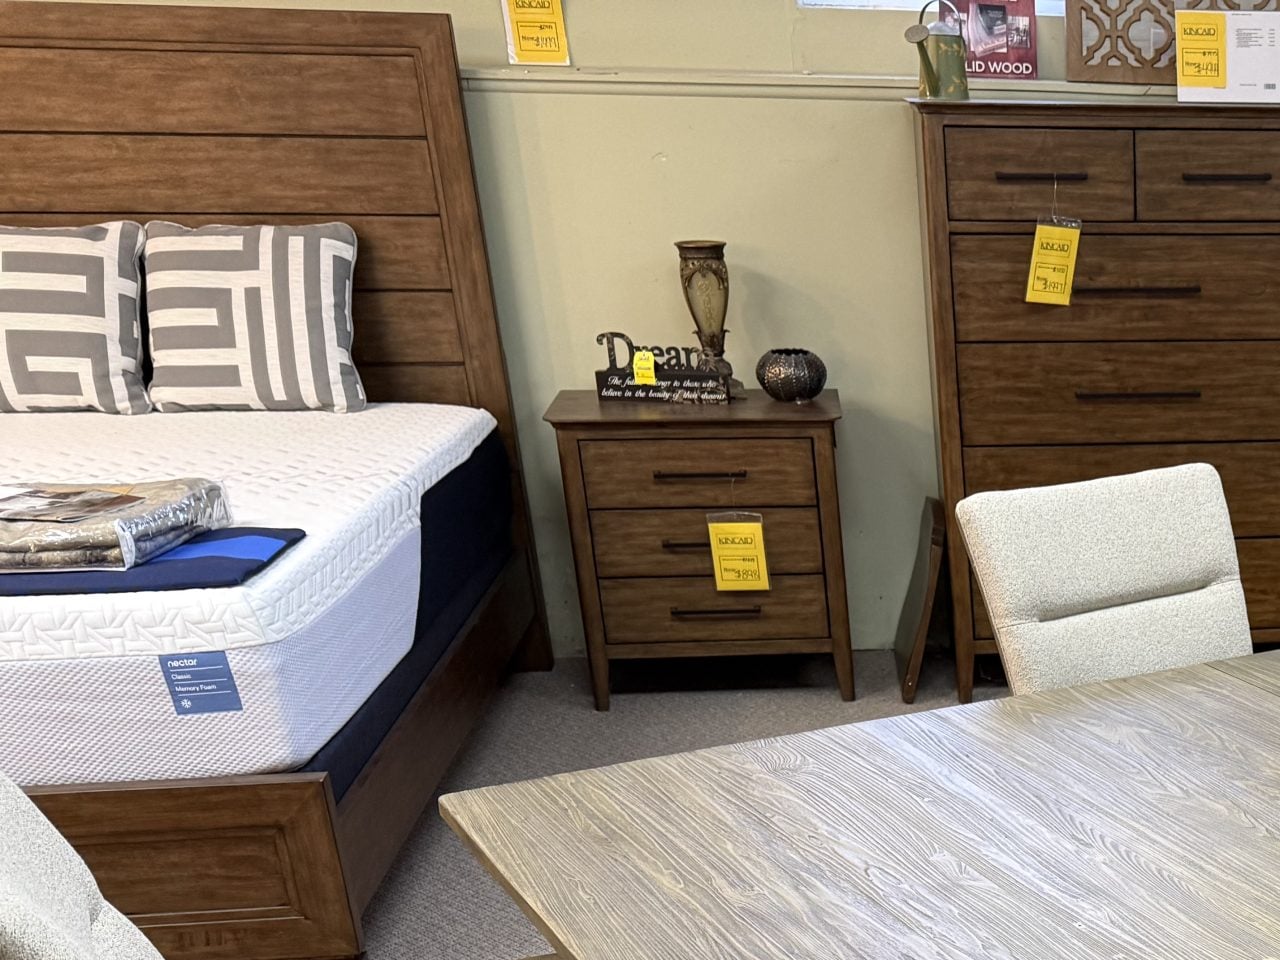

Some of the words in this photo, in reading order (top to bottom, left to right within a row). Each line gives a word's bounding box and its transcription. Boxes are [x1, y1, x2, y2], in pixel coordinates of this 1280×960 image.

[515, 0, 551, 8] KINCAID
[1183, 27, 1216, 36] KINCAID
[965, 60, 985, 72] LID
[988, 61, 1032, 74] WOOD
[1040, 241, 1070, 252] KINCAID
[718, 536, 754, 545] KINCAID
[167, 658, 197, 668] nectar
